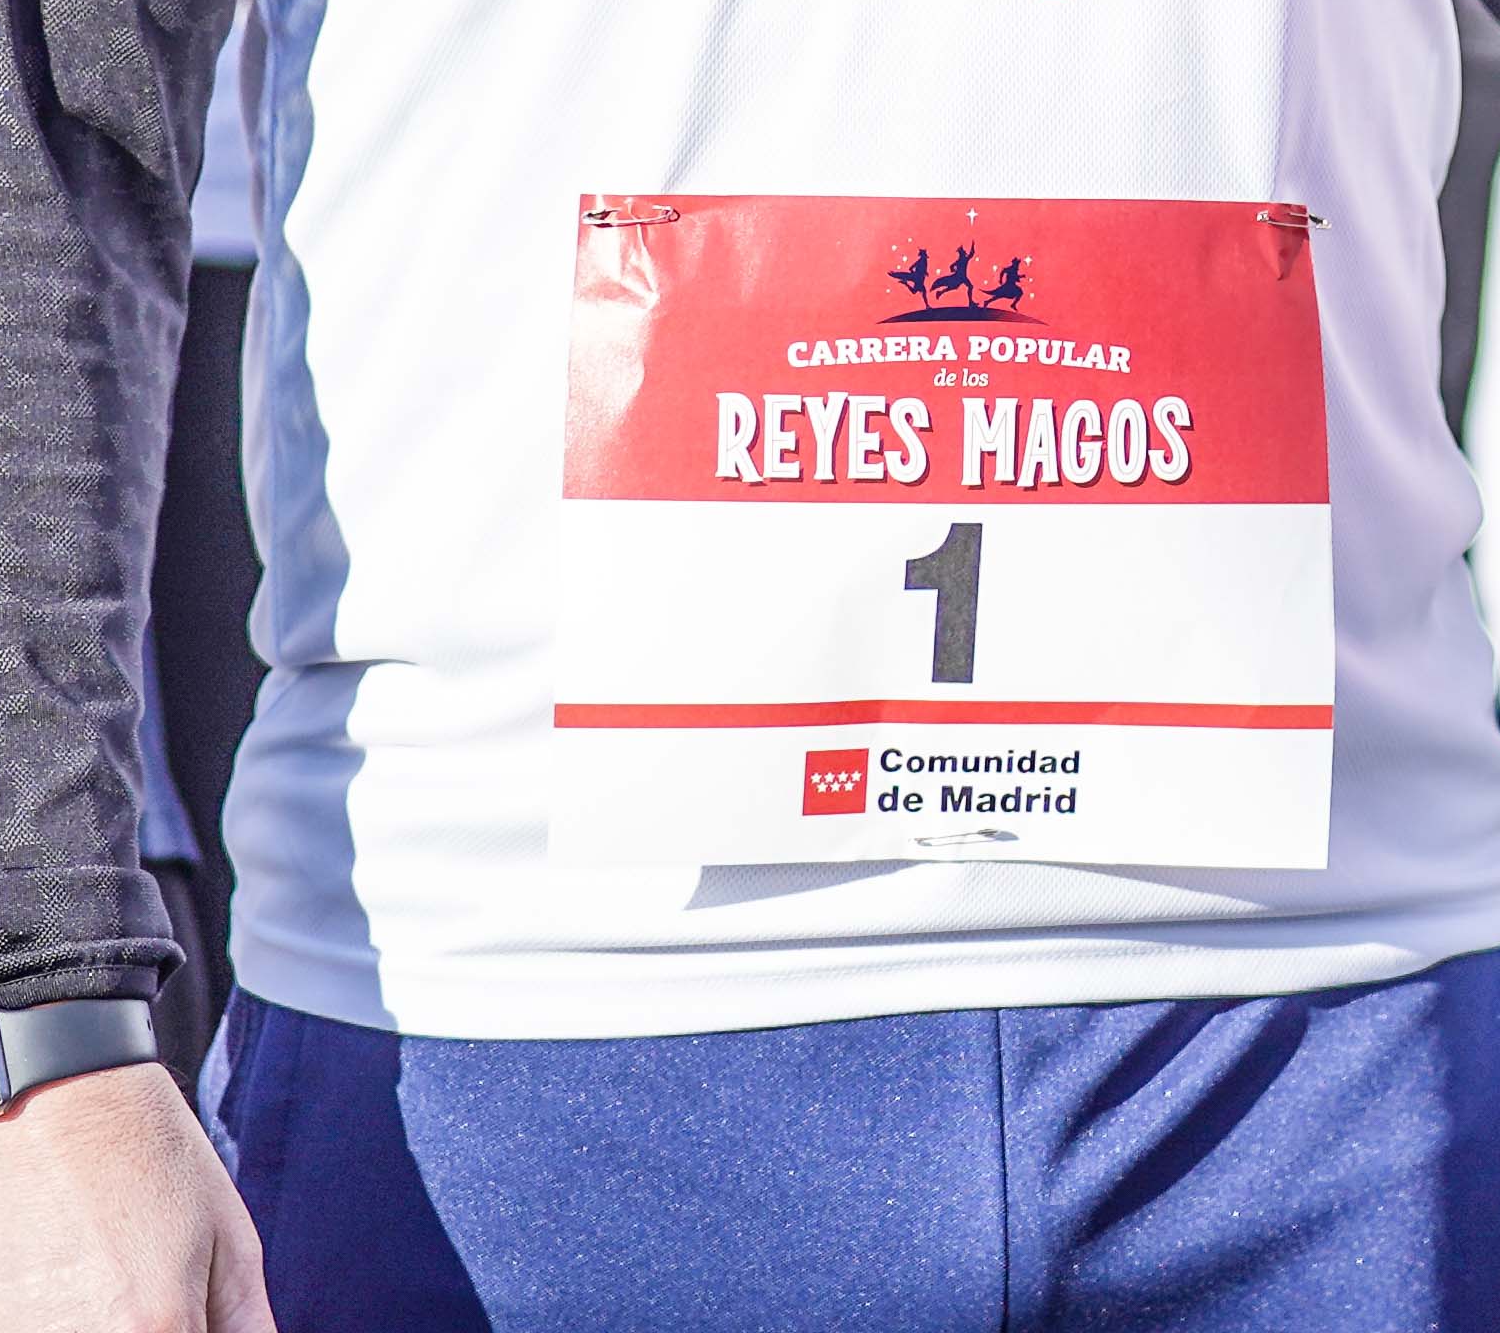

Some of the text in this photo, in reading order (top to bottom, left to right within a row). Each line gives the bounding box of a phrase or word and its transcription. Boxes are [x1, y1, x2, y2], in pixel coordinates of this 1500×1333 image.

[787, 336, 1131, 374] CARRERA POPULAR
[934, 367, 988, 388] de los
[715, 391, 1195, 488] REYES MAGOS
[904, 522, 983, 684] 1
[879, 749, 1081, 776] Comunidad
[877, 786, 1077, 815] de Madrid
